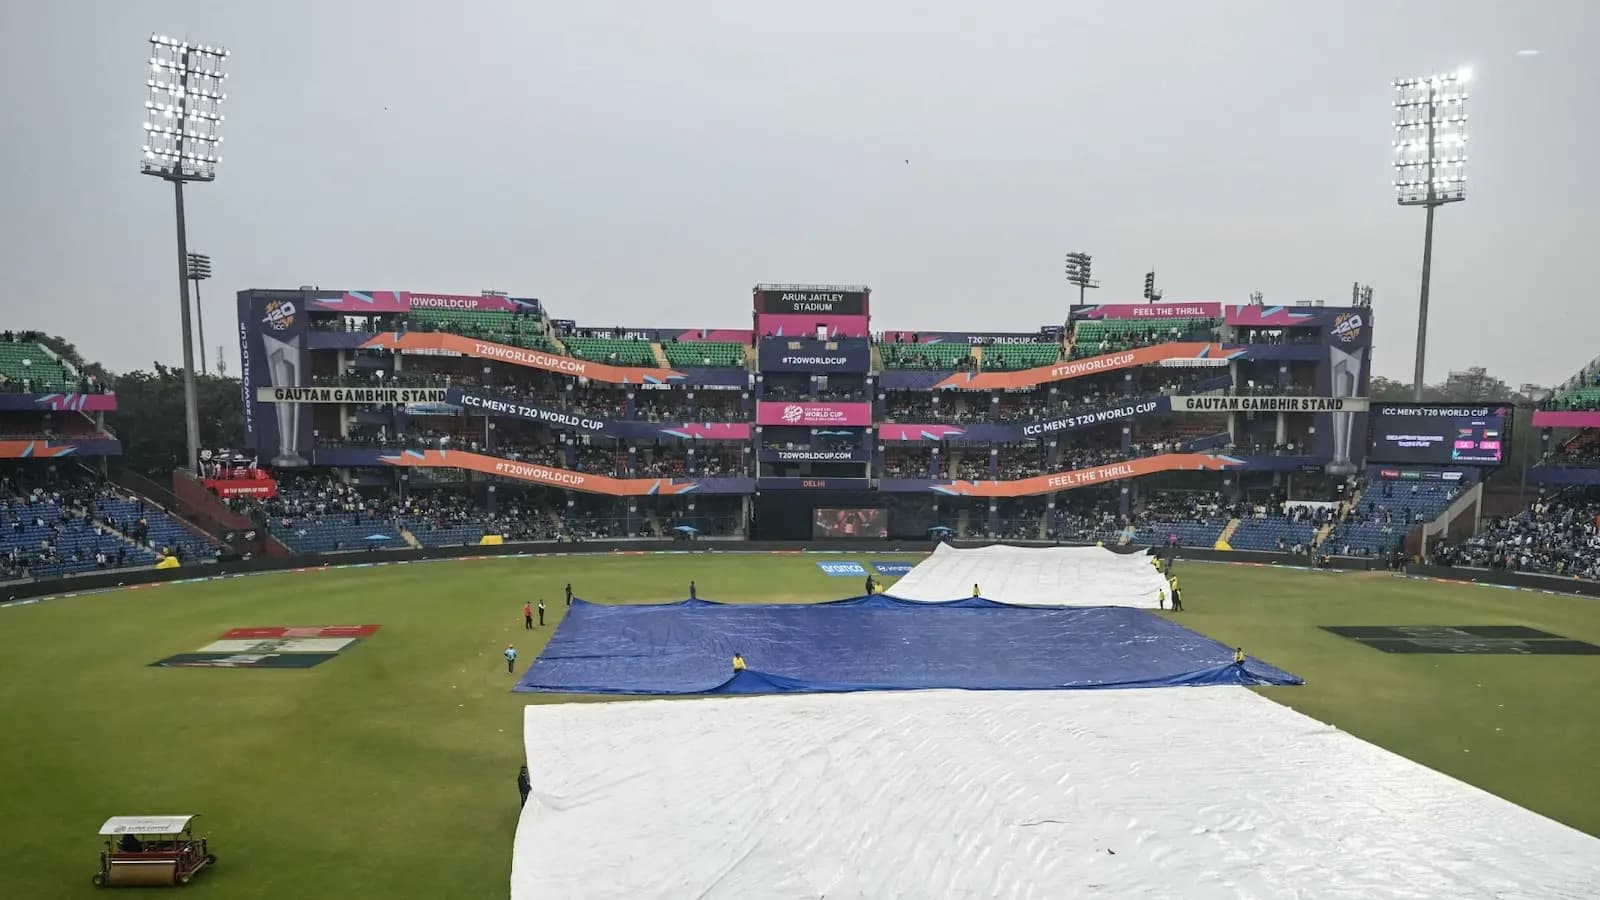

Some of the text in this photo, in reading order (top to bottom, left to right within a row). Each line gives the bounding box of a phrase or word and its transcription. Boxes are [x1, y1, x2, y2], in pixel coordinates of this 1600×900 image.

[782, 293, 844, 302] ARUN JAITLEY
[794, 302, 832, 312] STADIUM
[1134, 306, 1205, 316] FEEL THE THRILL
[474, 343, 586, 374] T20WORLDCUP.COM
[782, 356, 847, 365] #T20WORLDCUP
[1051, 354, 1135, 378] #T20WORLDCUP
[240, 322, 252, 432] #T20WORLDCUP
[275, 388, 446, 402] GAUTAM GAMBHIR STAND
[1186, 398, 1344, 411] GAUTAM GAMBHIR STAND
[461, 395, 604, 431] ICC MEN'S T20 WORLD CUP
[1024, 402, 1157, 436] ICC MEN'S T20 WORLD CUP
[1382, 408, 1396, 416] ICC
[1397, 408, 1422, 416] MEN'S
[1440, 408, 1470, 417] WORLD
[1472, 408, 1488, 417] CUP
[778, 452, 852, 460] T20WORLDCUP.COM
[495, 462, 585, 485] #T20WORLDCUP
[1048, 465, 1134, 488] FEEL THE THRILL
[822, 565, 865, 573] aramco
